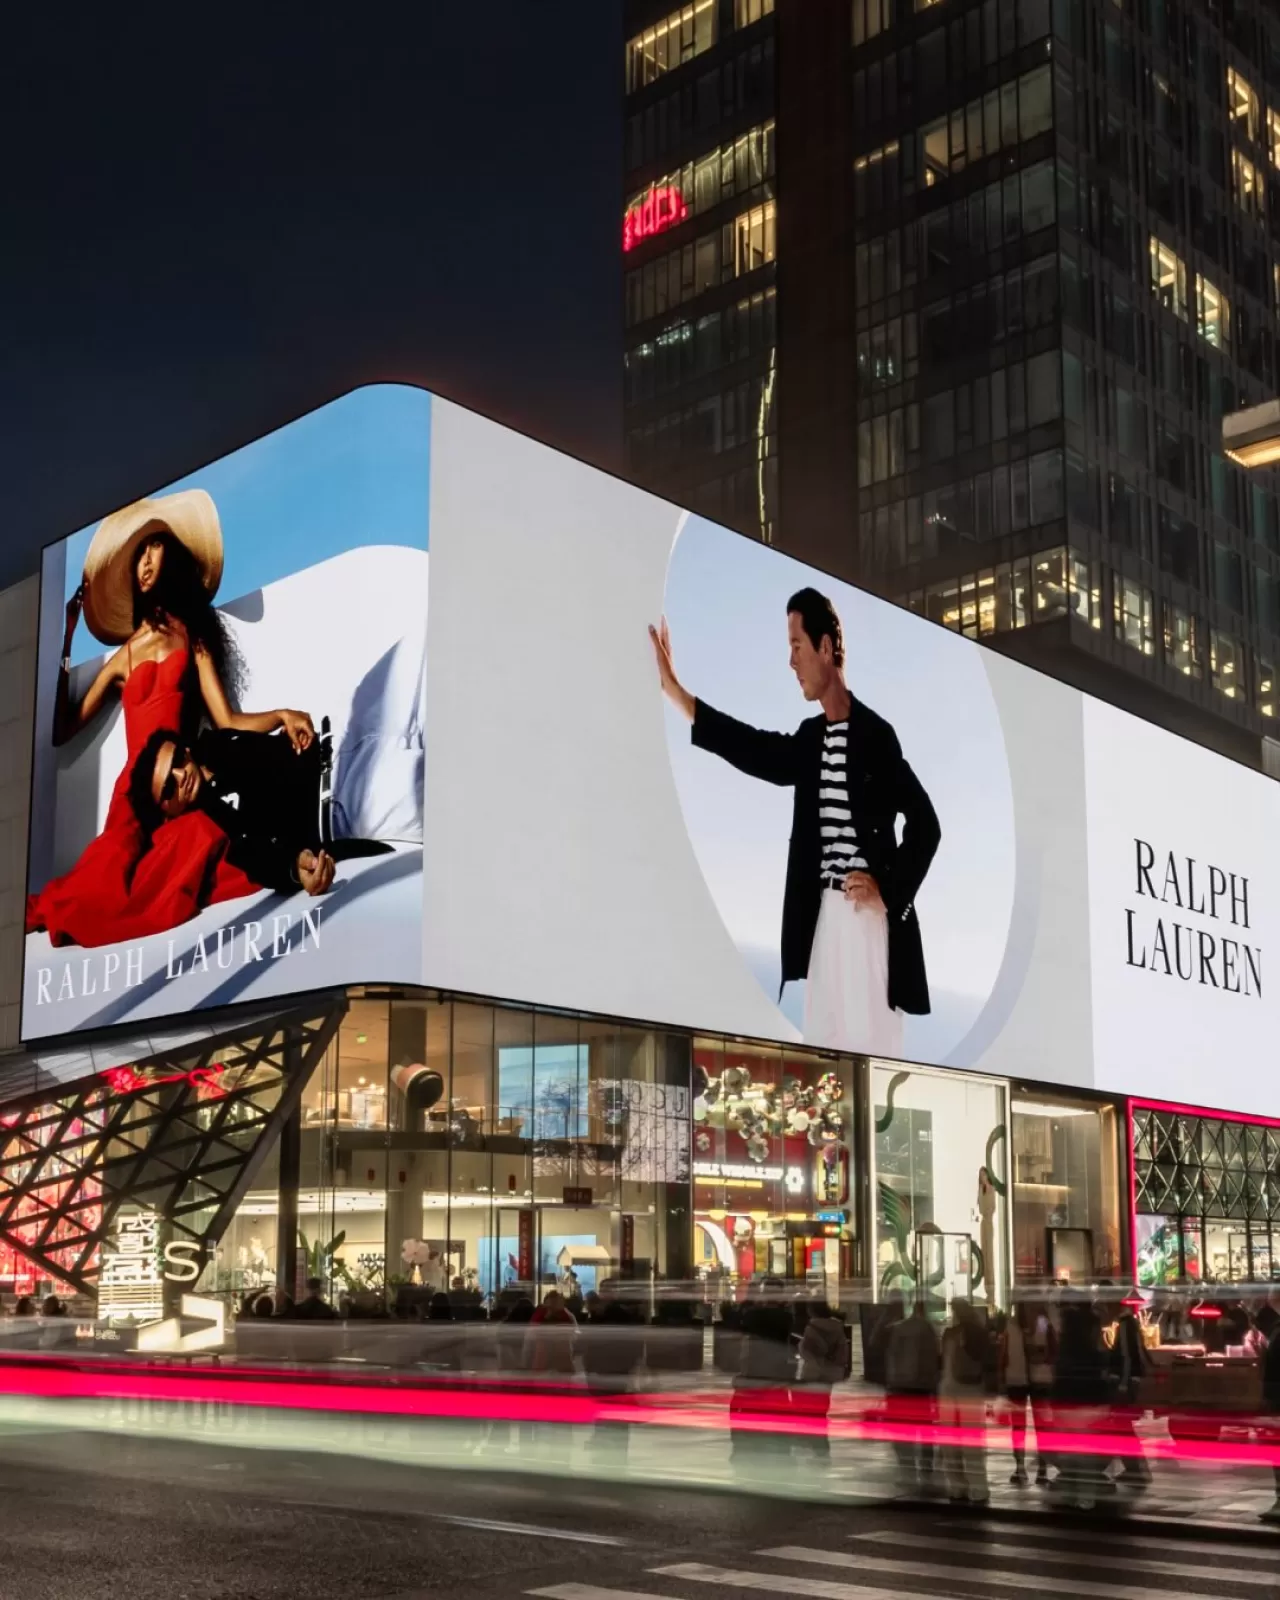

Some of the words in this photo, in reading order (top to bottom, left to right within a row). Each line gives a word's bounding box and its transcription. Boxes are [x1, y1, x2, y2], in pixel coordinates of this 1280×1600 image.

[1133, 838, 1250, 929] RALPH
[36, 946, 145, 1006] RALPH
[165, 907, 323, 979] LAUREN
[1125, 908, 1262, 1000] LAUREN
